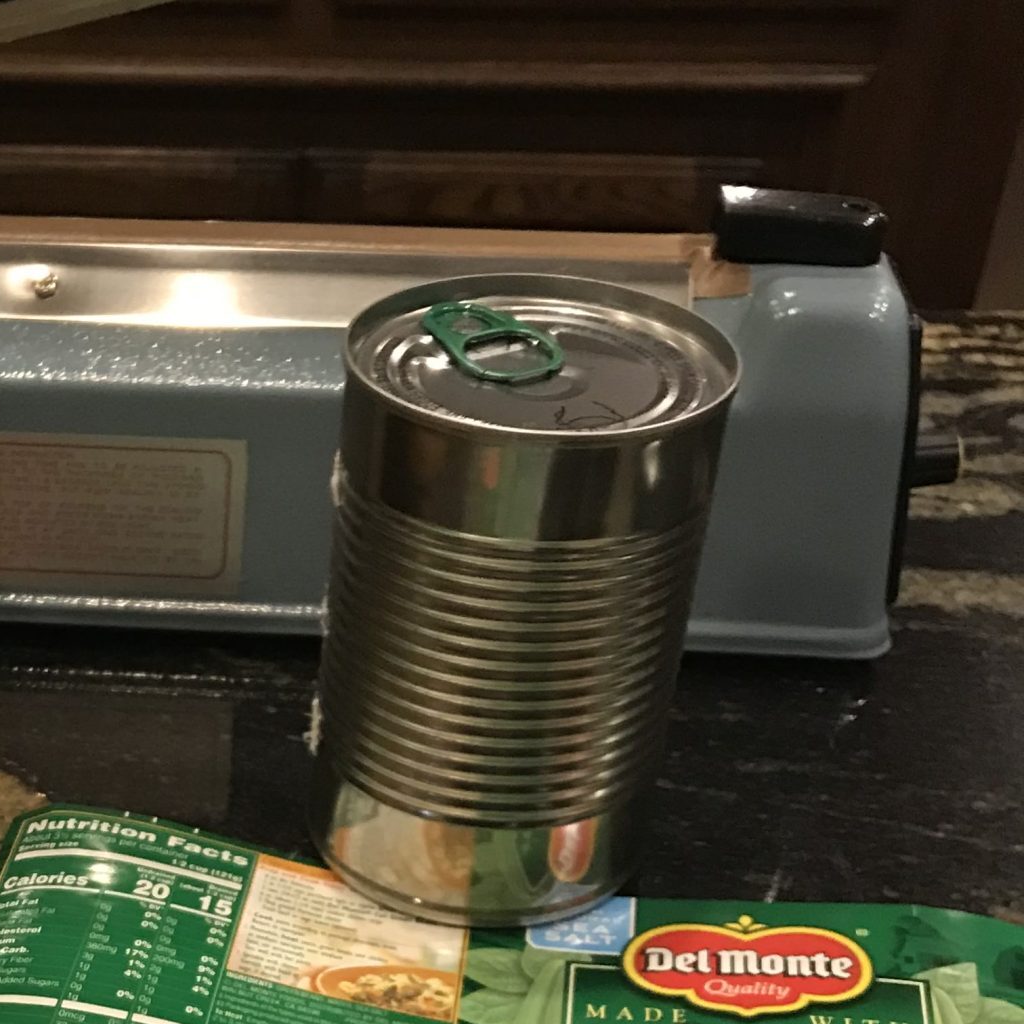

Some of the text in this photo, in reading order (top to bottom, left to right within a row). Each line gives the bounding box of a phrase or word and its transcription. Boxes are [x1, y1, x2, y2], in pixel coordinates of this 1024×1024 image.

[26, 818, 248, 866] Nutrition Facts
[3, 871, 89, 890] Calories
[133, 879, 170, 899] 20
[198, 895, 233, 916] 15
[645, 947, 854, 978] Del Monte
[704, 978, 791, 998] Quality
[585, 1003, 688, 1024] MADE
